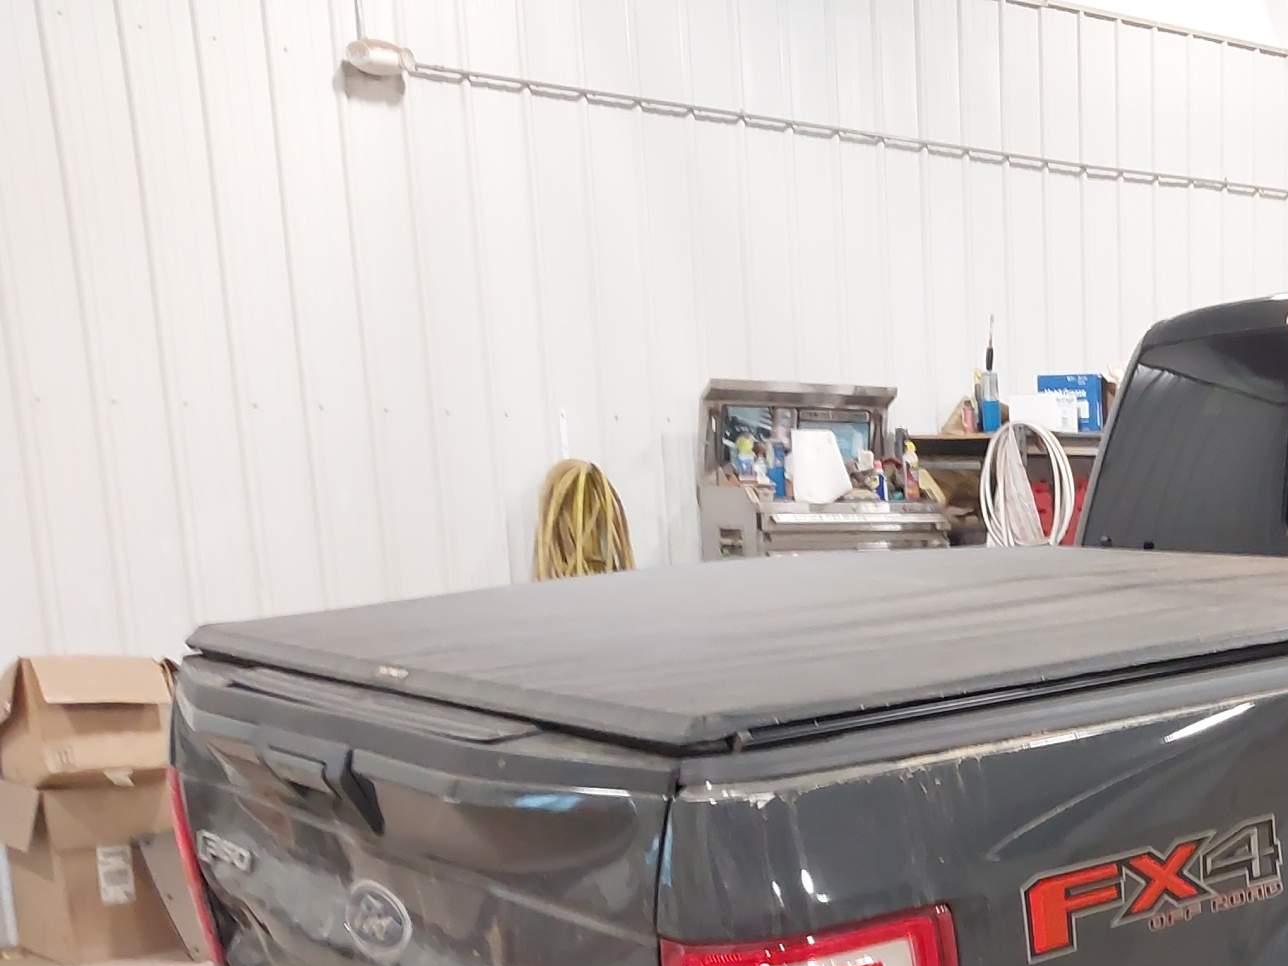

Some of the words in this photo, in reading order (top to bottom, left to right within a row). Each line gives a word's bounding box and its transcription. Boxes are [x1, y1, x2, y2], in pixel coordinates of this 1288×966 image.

[1020, 812, 1283, 965] FX4
[1148, 902, 1202, 932] OFF
[1211, 882, 1284, 913] ROAD
